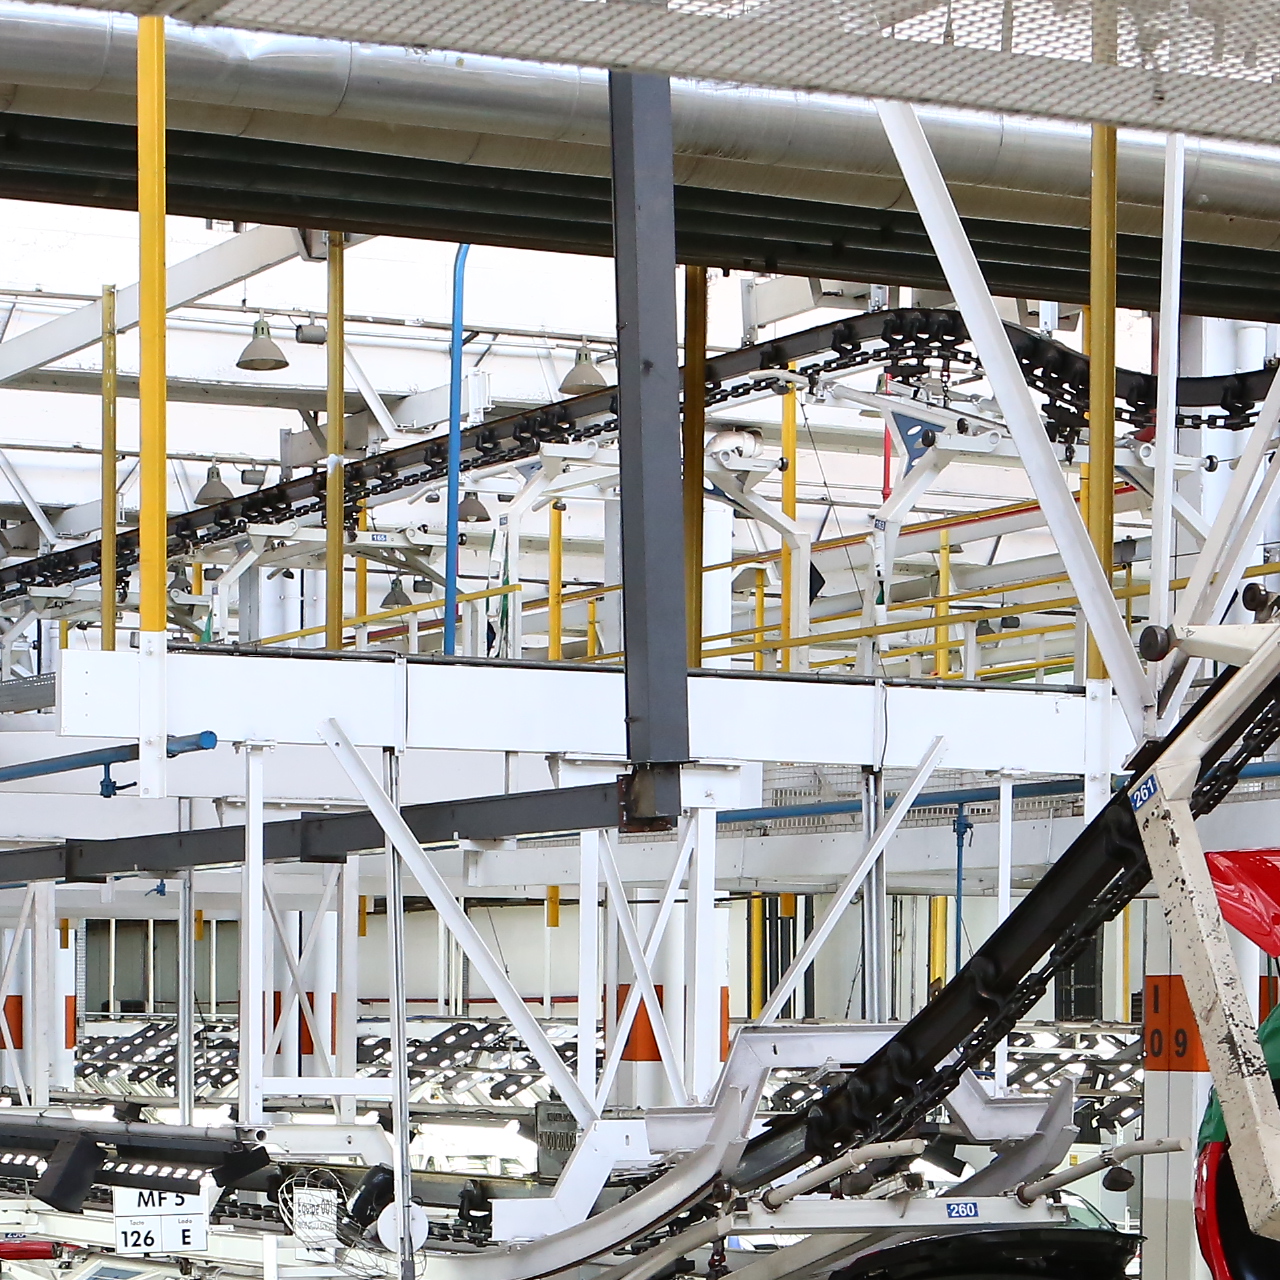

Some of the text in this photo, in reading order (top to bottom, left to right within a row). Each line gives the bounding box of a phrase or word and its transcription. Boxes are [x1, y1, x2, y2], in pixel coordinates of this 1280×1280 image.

[1134, 778, 1154, 808] 261
[138, 1190, 185, 1207] MF 5
[950, 1203, 975, 1217] 260
[121, 1229, 191, 1248] 126 E
